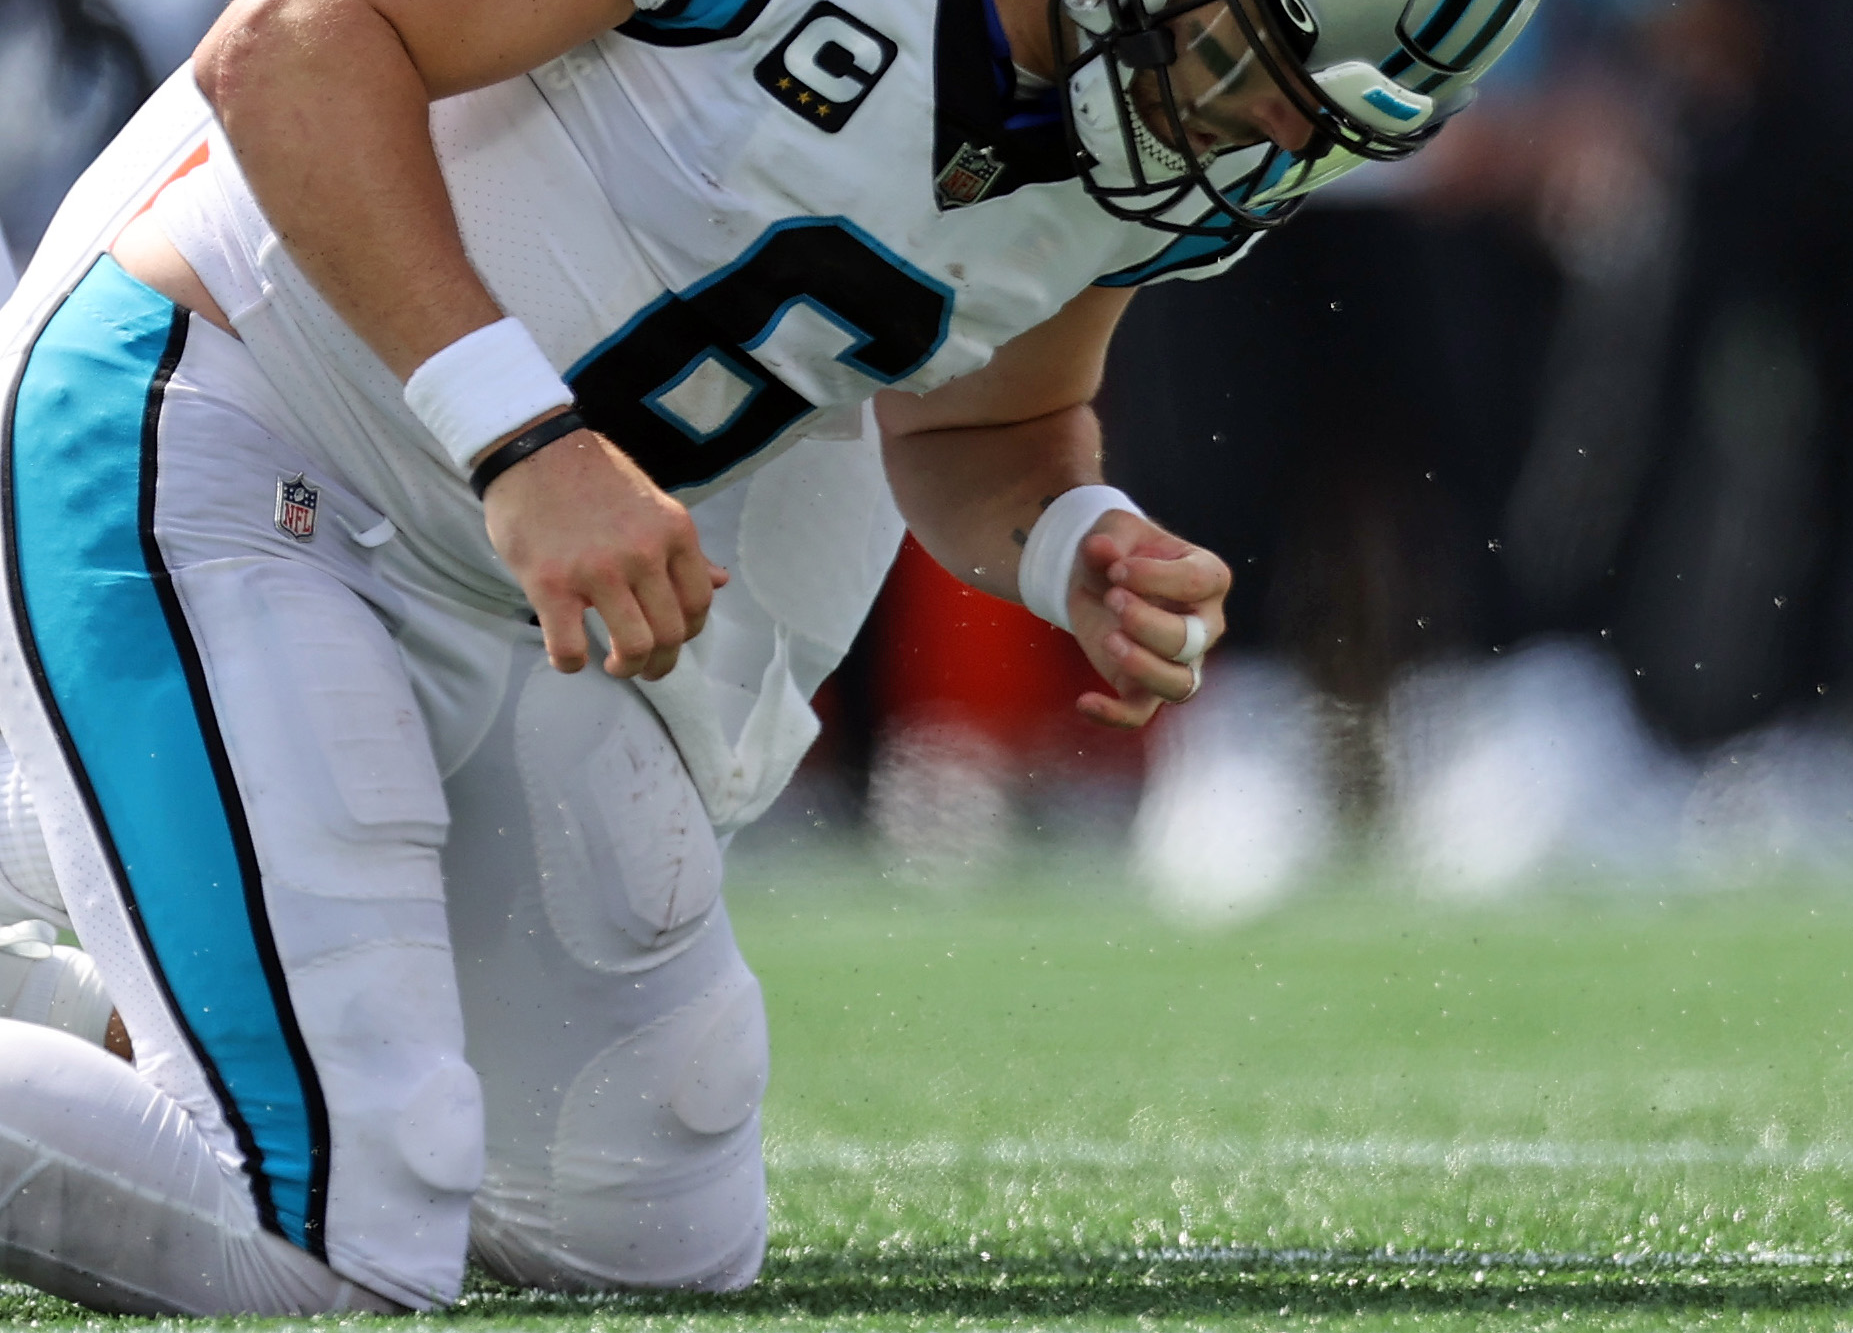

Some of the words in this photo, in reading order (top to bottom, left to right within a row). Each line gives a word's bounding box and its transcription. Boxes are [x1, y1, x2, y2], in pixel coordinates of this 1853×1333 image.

[783, 16, 882, 103] C
[562, 214, 955, 494] 6
[283, 501, 312, 534] NFL
